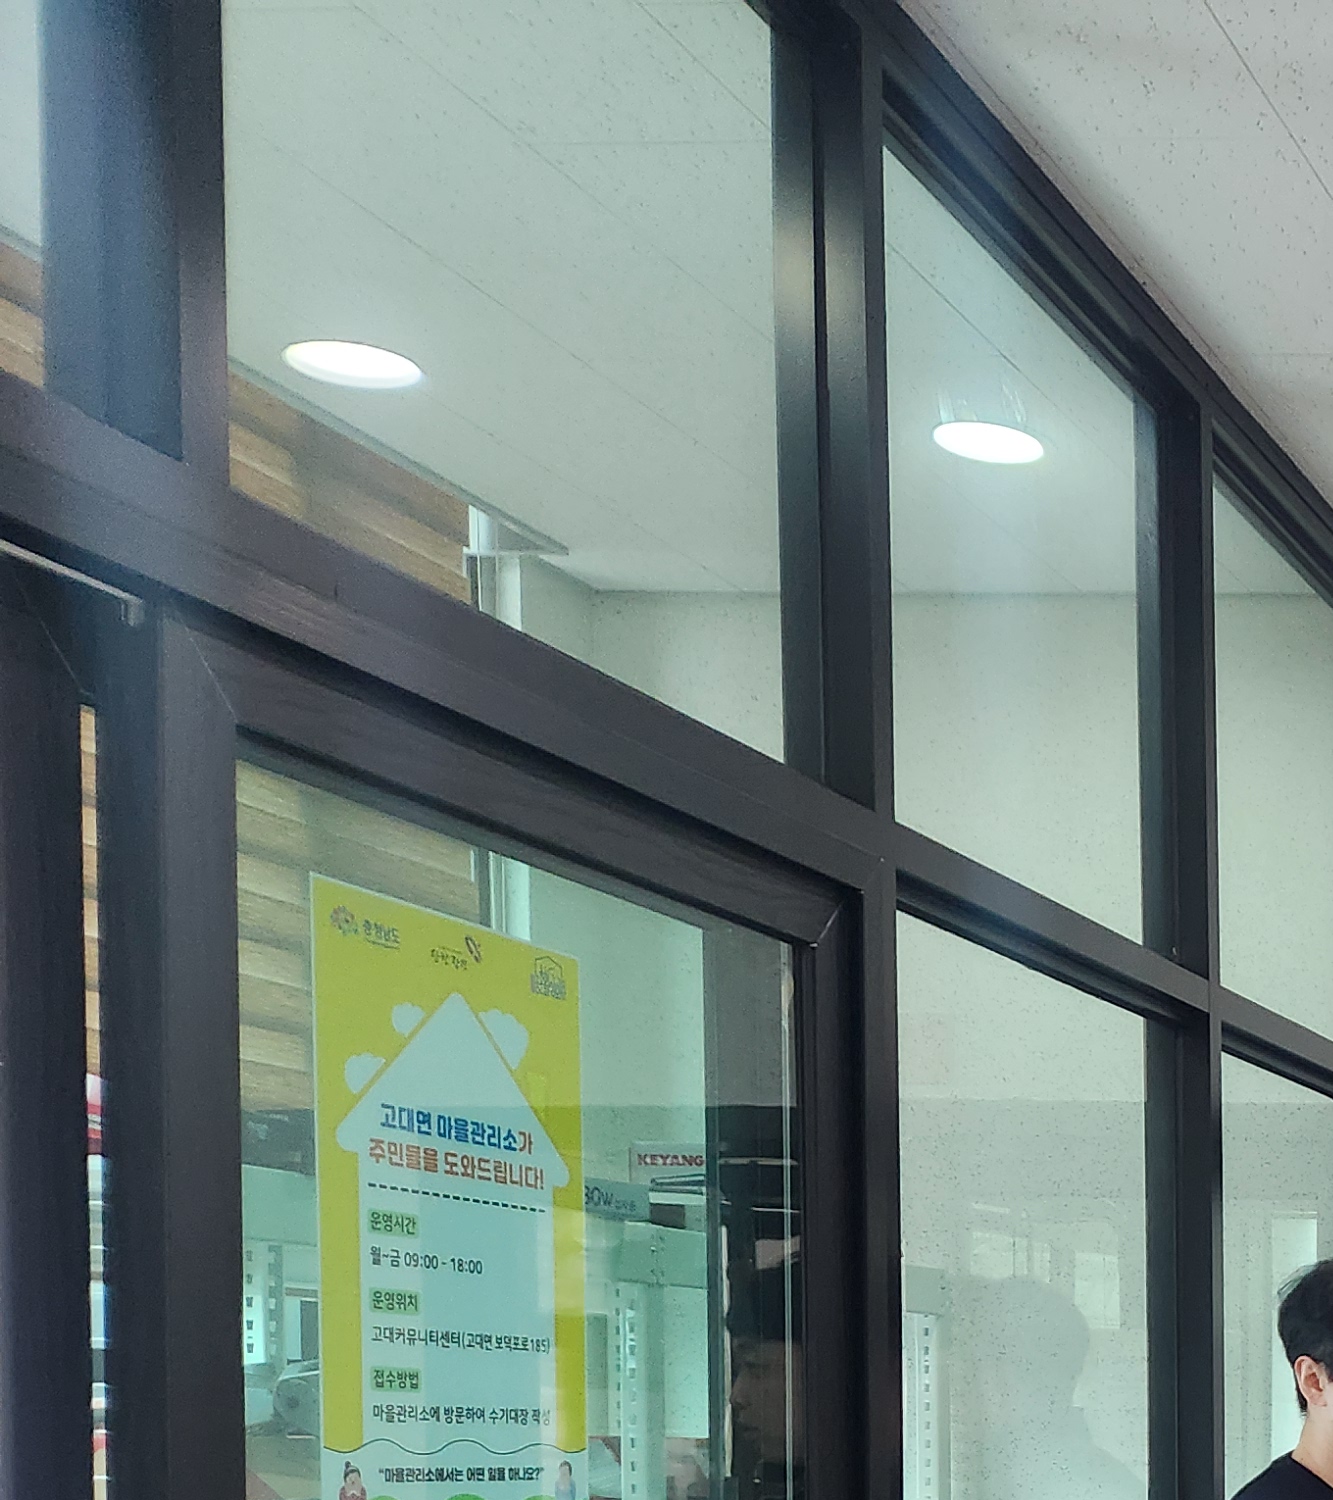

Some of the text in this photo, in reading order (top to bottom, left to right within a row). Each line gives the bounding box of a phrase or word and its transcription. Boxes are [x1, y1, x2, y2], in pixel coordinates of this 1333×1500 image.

[380, 1103, 533, 1155] 고대면 마을관리소가
[369, 1138, 544, 1190] 주민들을 도와드립니다!
[637, 1153, 704, 1167] KEYANG
[371, 1211, 417, 1235] 운영시간
[370, 1246, 401, 1267] 월~금
[404, 1252, 439, 1269] 09:00
[450, 1258, 483, 1274] 18:00
[373, 1290, 418, 1312] 운영위치
[373, 1369, 419, 1389] 접수방법
[372, 1404, 440, 1423] 마을관리소에
[443, 1406, 486, 1425] 방문하여
[488, 1408, 529, 1426] 수기대장
